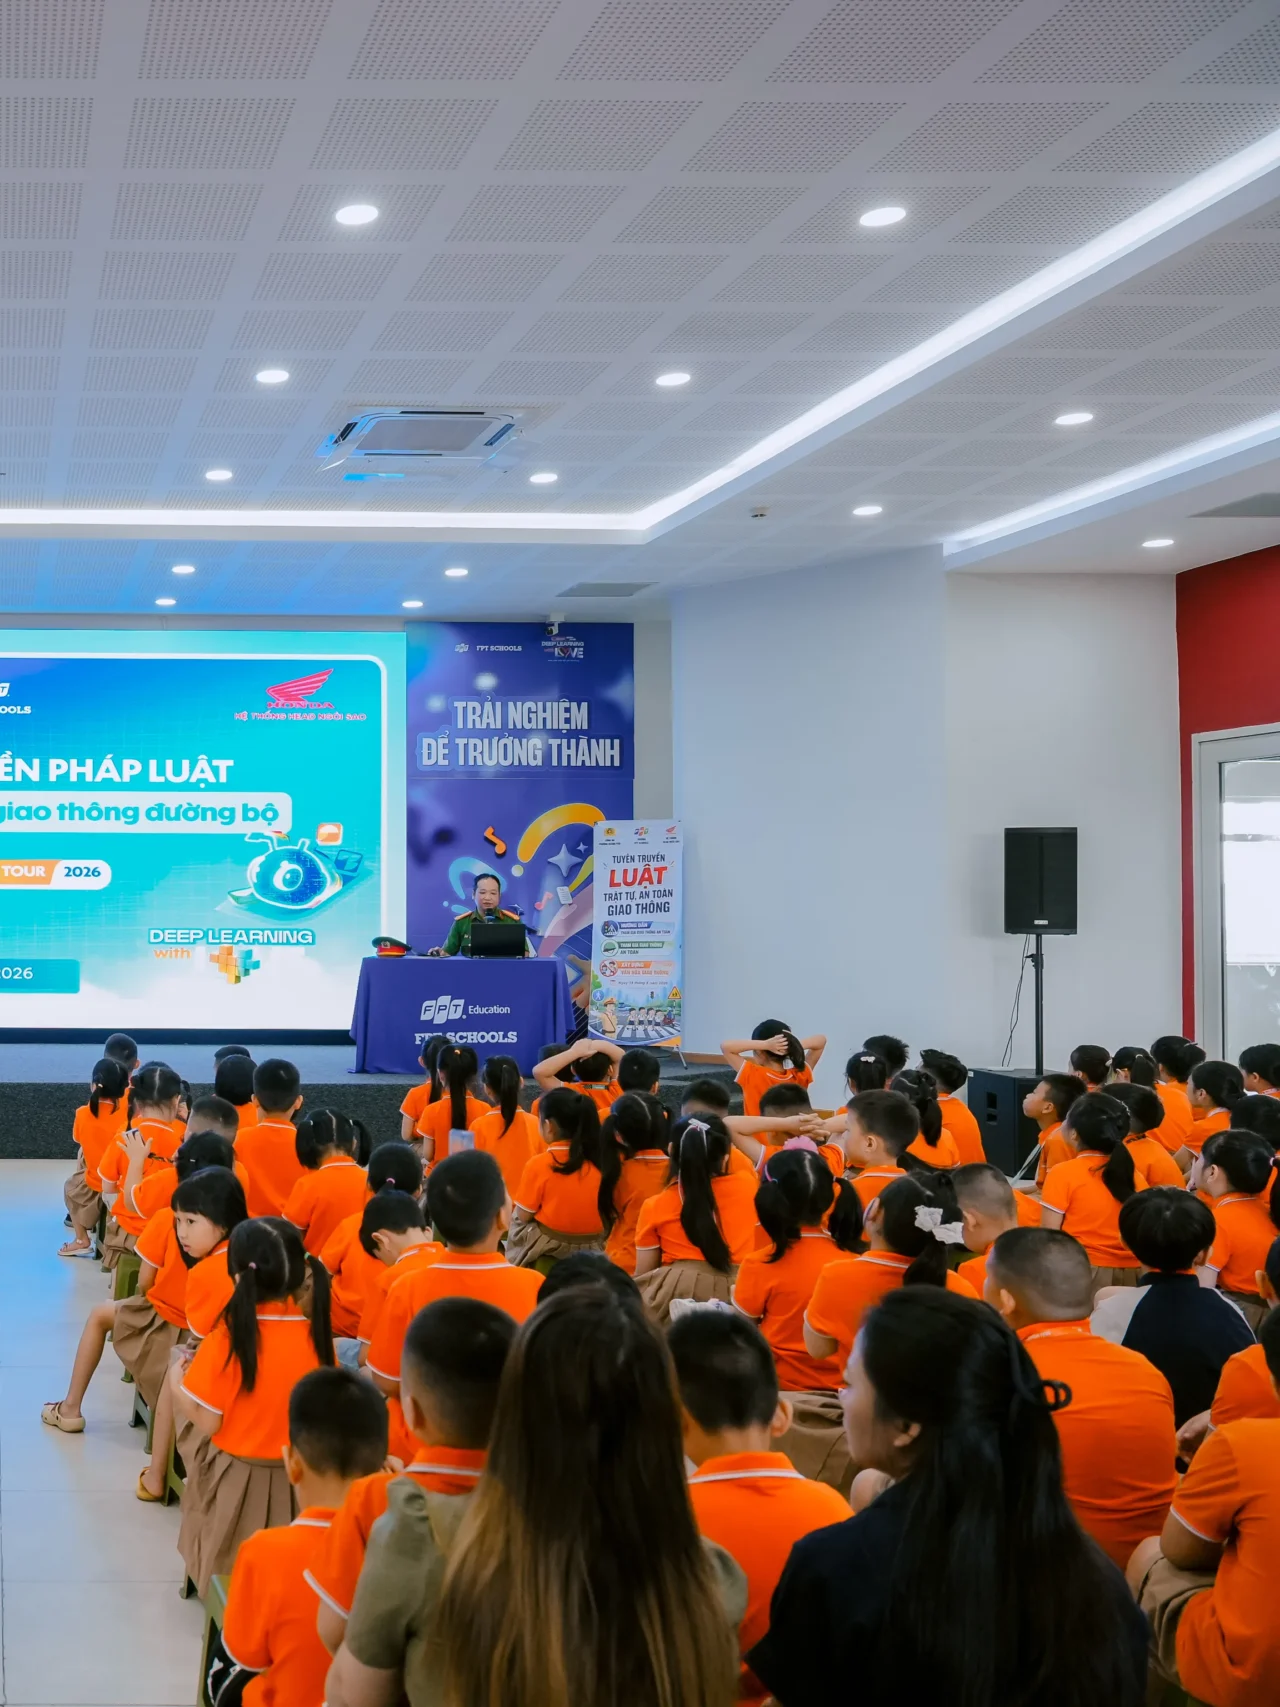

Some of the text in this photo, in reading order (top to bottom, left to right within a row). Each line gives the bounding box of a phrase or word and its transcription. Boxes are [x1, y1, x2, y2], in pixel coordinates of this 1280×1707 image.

[267, 701, 335, 709] HONDA
[288, 712, 316, 720] HEAD
[453, 696, 588, 733] TRẢI NGHIỆM
[421, 730, 620, 767] ĐỂ TRƯỞNG THÀNH
[49, 754, 142, 783] PHÁP
[148, 754, 234, 788] LUẬT
[56, 802, 140, 825] thông
[145, 802, 236, 825] đường
[241, 803, 279, 826] bộ
[1, 865, 46, 877] TOUR
[64, 866, 102, 878] 2026
[609, 863, 668, 889] LUẬT
[604, 891, 623, 903] TRẬT
[639, 890, 650, 900] AN
[652, 888, 673, 899] TOÀN
[608, 900, 670, 916] GIAO THÔNG
[149, 929, 313, 944] DEEP LEARNING
[154, 947, 191, 959] with
[468, 1004, 511, 1015] Education
[446, 1031, 517, 1044] SCHOOLS
